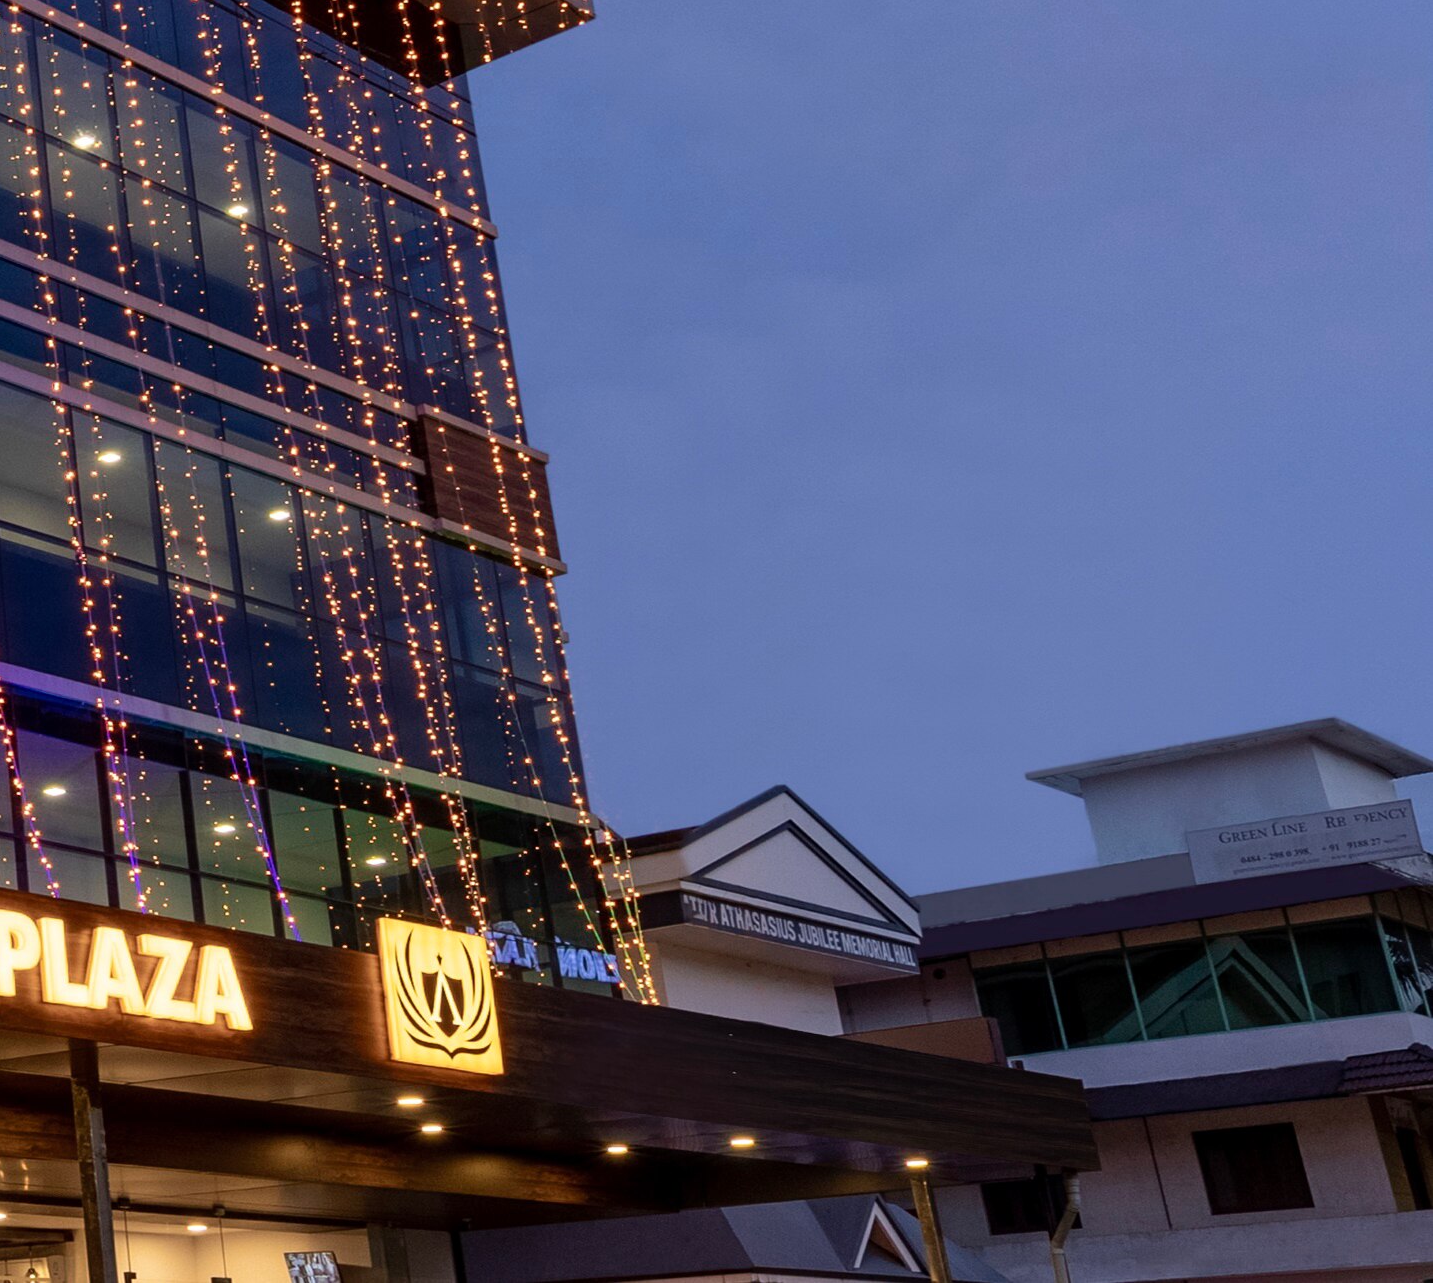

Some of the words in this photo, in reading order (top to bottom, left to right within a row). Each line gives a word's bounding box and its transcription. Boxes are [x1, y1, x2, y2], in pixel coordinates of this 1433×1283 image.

[1218, 828, 1268, 844] GREEN
[1271, 821, 1308, 837] LINE
[797, 923, 842, 951] JUBILEE
[841, 935, 894, 962] MEMORIAL
[893, 944, 916, 967] HALL
